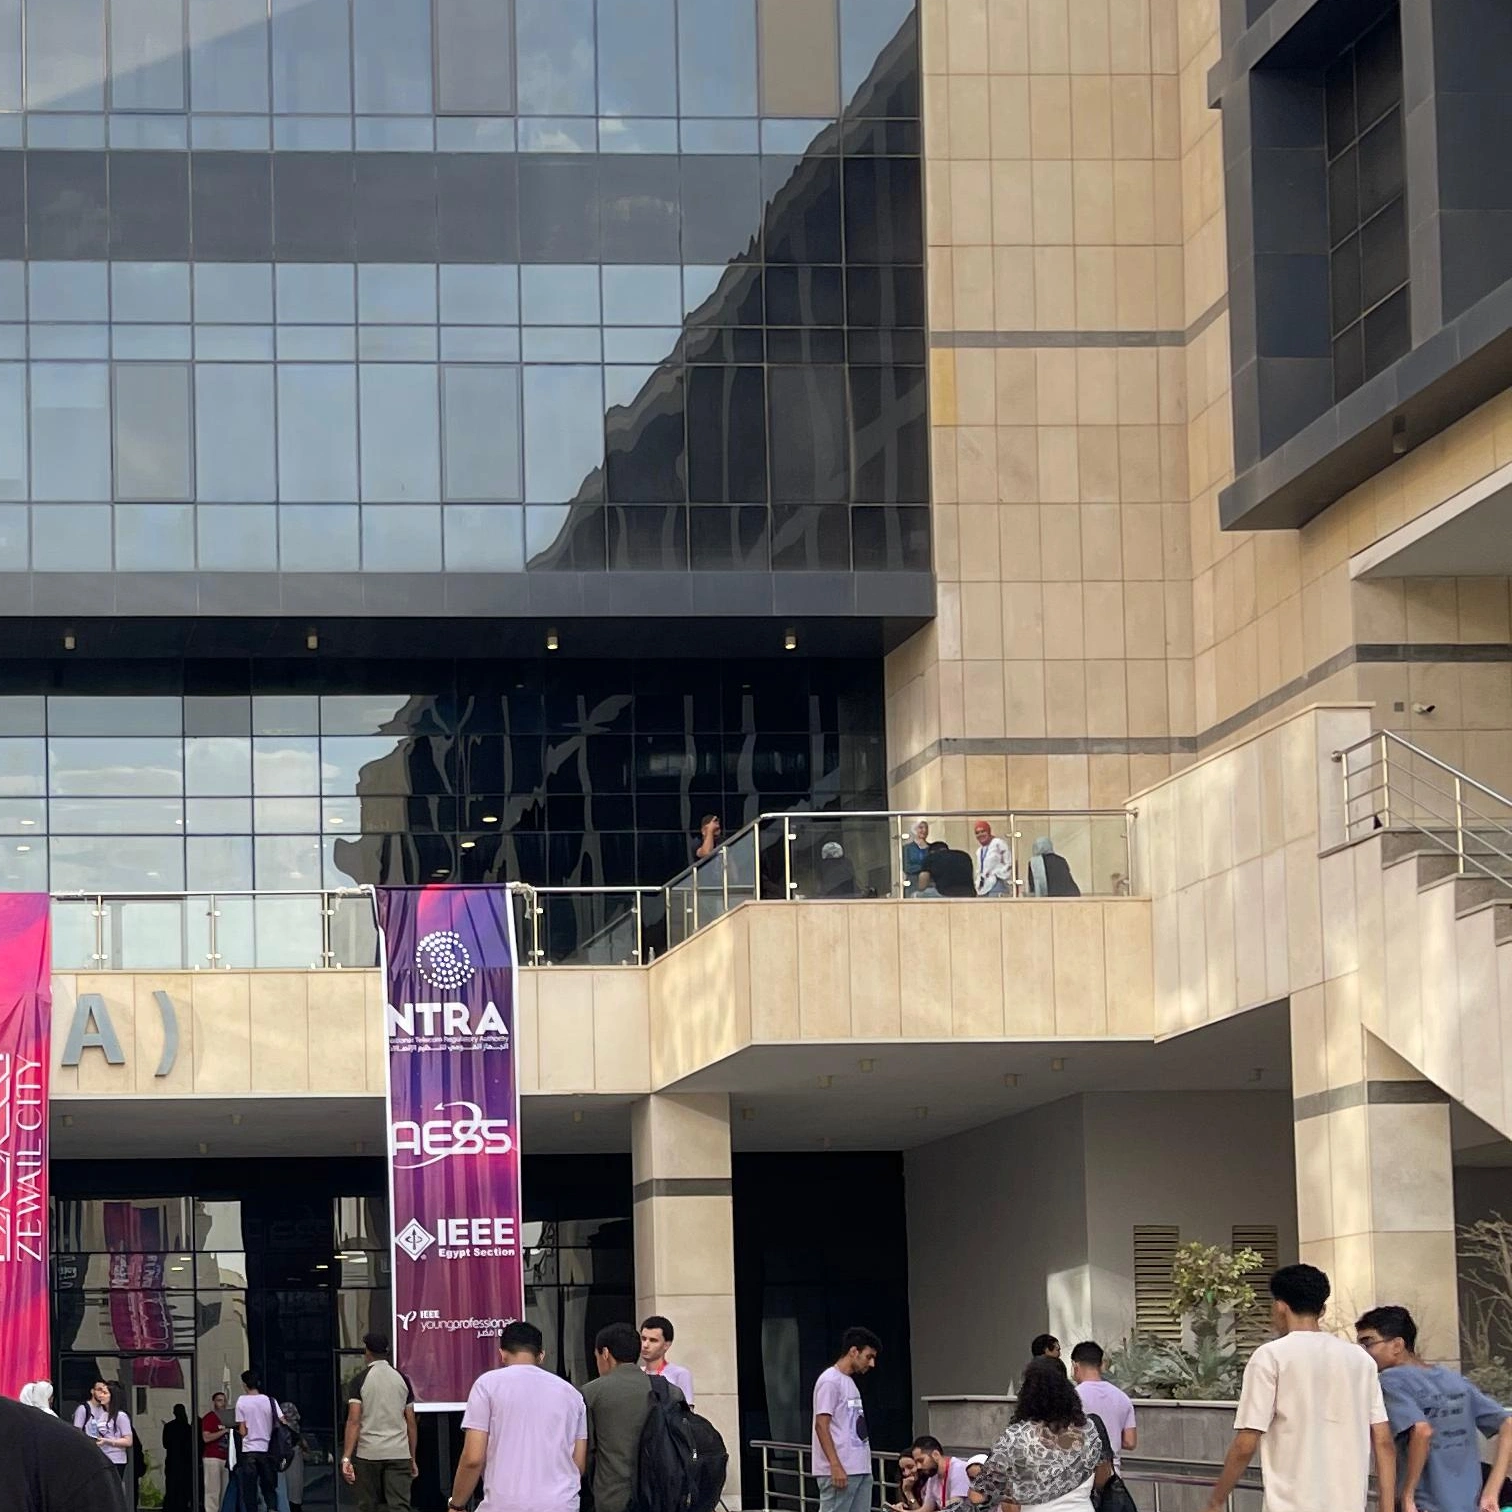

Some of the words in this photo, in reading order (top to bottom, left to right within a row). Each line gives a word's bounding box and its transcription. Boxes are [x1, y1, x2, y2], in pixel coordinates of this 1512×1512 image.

[388, 1001, 509, 1036] NTRA
[15, 1054, 42, 1131] CITY
[16, 1138, 42, 1263] ZEWAIL
[437, 1218, 515, 1246] IEEE
[438, 1248, 470, 1259] Egypt
[473, 1247, 515, 1257] Section
[420, 1310, 440, 1319] IEEE
